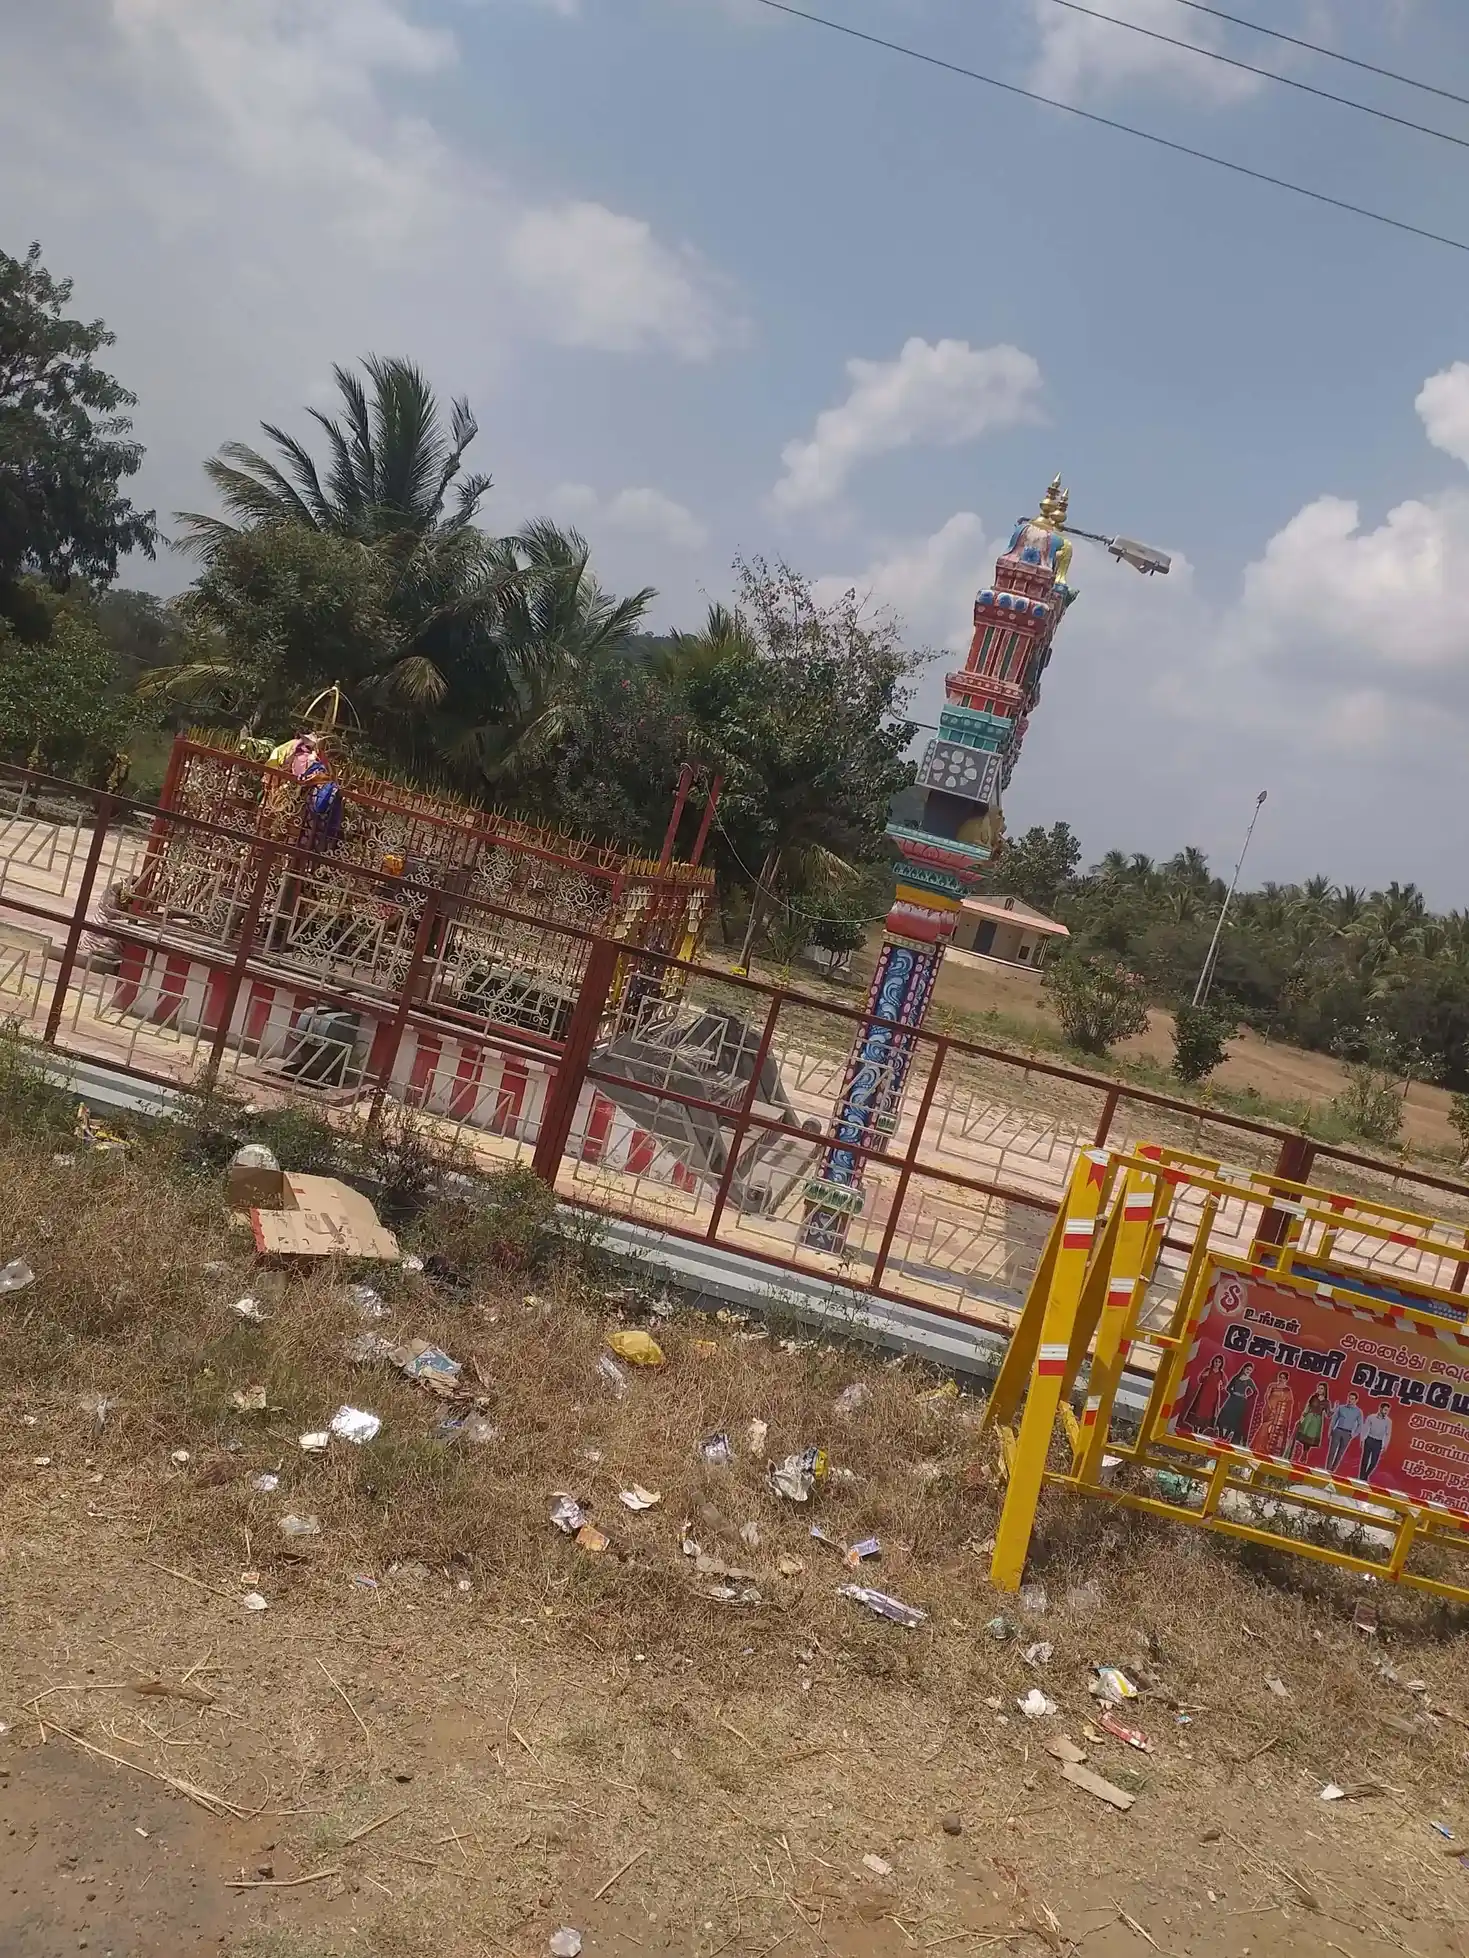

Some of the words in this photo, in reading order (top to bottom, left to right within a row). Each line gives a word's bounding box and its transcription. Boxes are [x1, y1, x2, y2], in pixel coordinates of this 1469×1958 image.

[1244, 1308, 1300, 1334] உங்கள்
[1223, 1324, 1346, 1379] சோனி
[1340, 1333, 1427, 1371] அனைத்து
